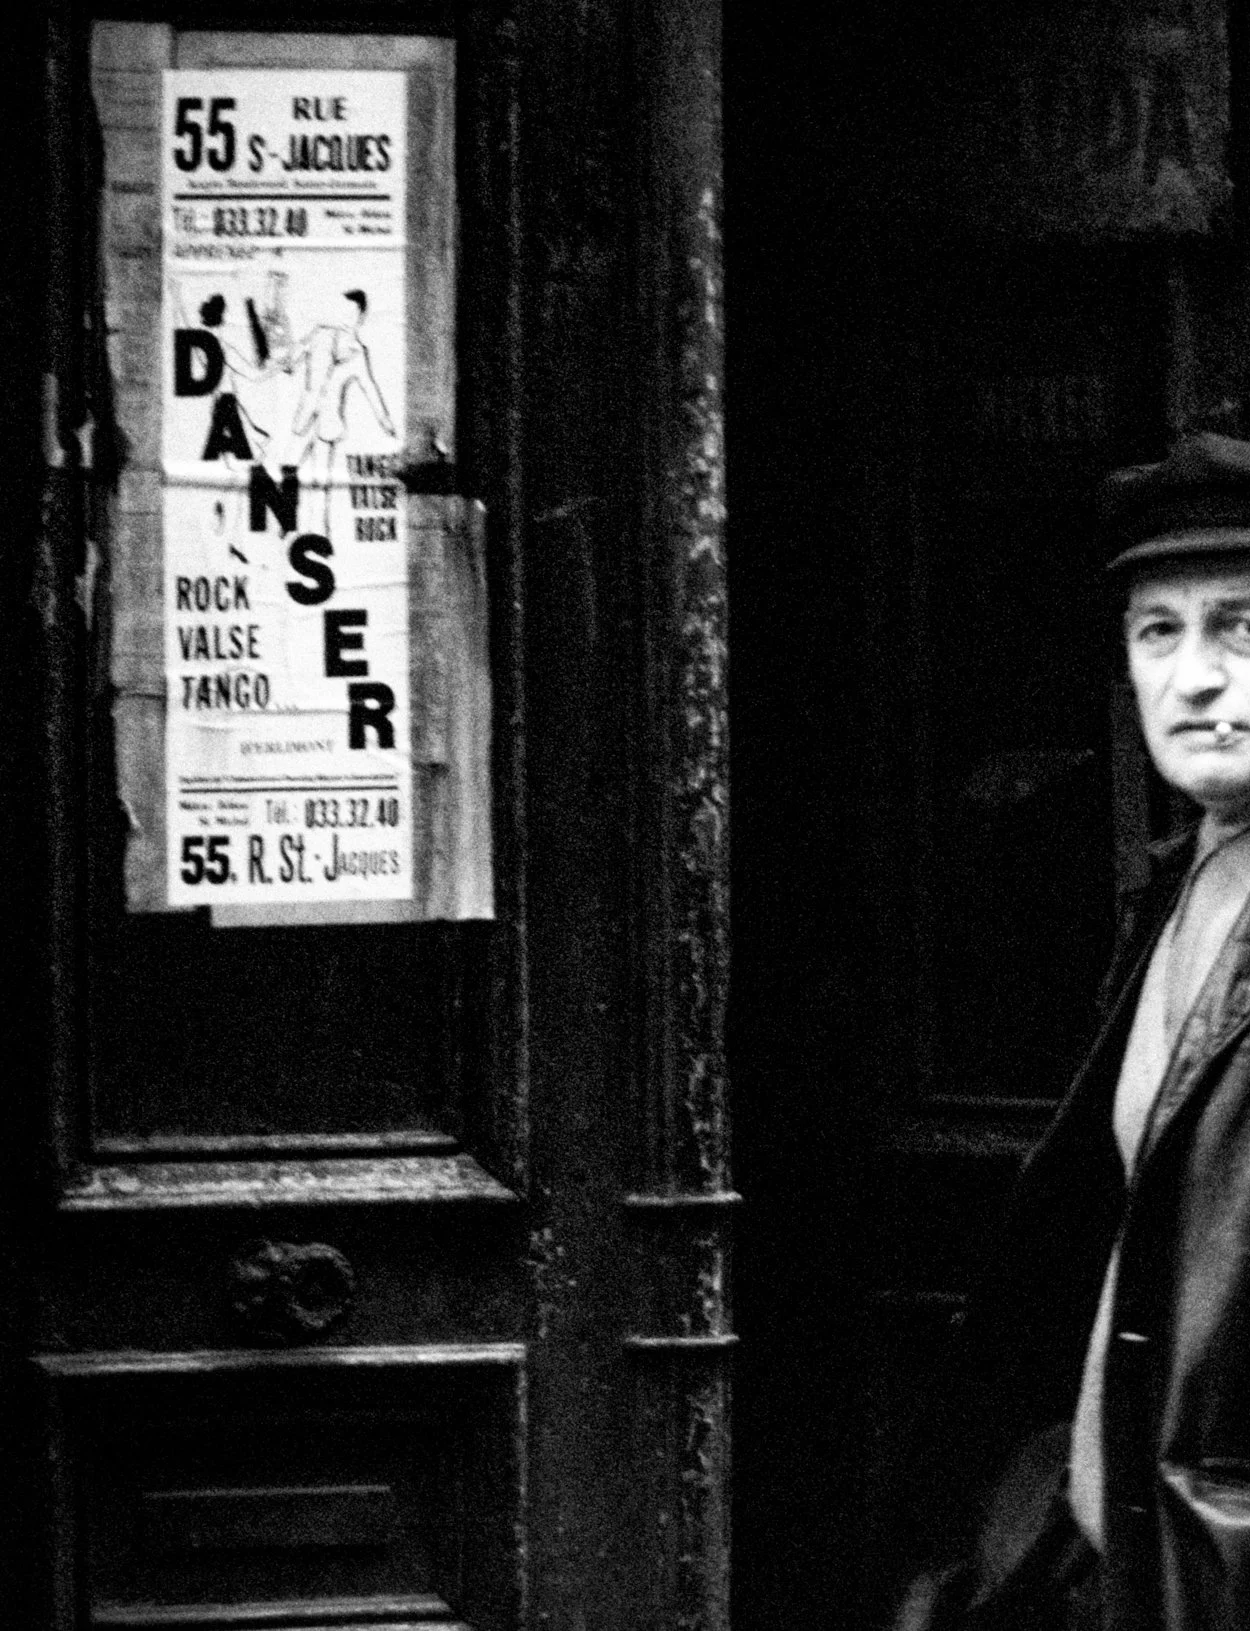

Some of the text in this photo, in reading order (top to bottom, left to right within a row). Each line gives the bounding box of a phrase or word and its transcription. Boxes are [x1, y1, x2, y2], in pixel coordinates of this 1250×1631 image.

[292, 96, 348, 121] RUE
[173, 97, 237, 172] 55
[174, 328, 396, 750] DANSER
[176, 575, 250, 612] ROCK
[177, 623, 262, 661] VALSE
[304, 797, 399, 828] 033.32.40
[248, 834, 273, 884] R.
